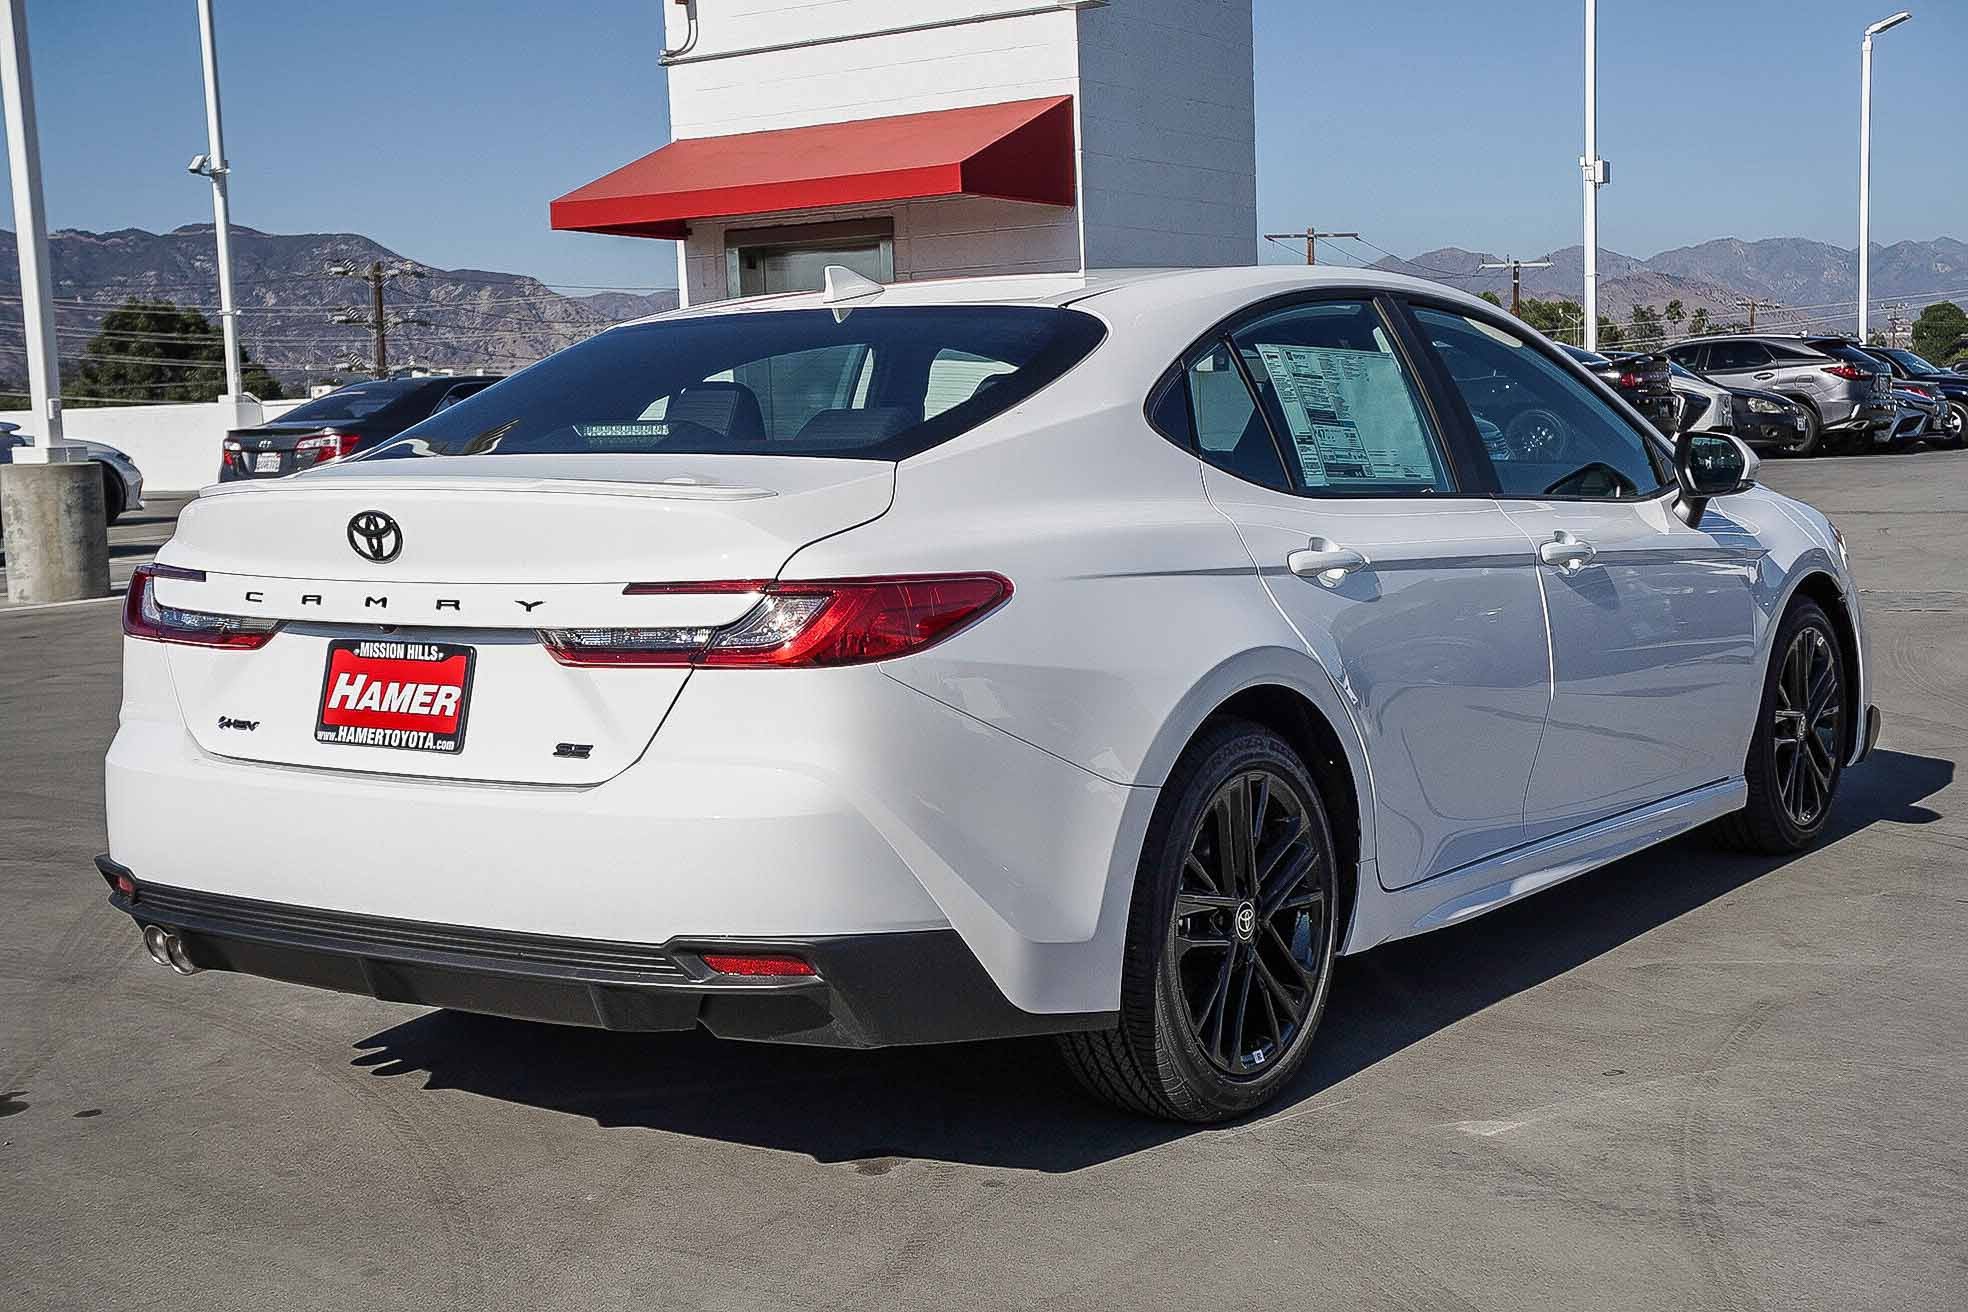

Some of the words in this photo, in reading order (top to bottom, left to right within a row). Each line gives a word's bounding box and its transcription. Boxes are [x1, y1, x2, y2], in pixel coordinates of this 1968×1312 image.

[245, 591, 544, 613] CAMRY
[360, 642, 403, 659] MISSION
[406, 644, 439, 661] HILLS
[328, 672, 462, 717] HAMER
[317, 726, 455, 750] www.HAMERTOYOTA.com
[553, 743, 594, 759] SE
